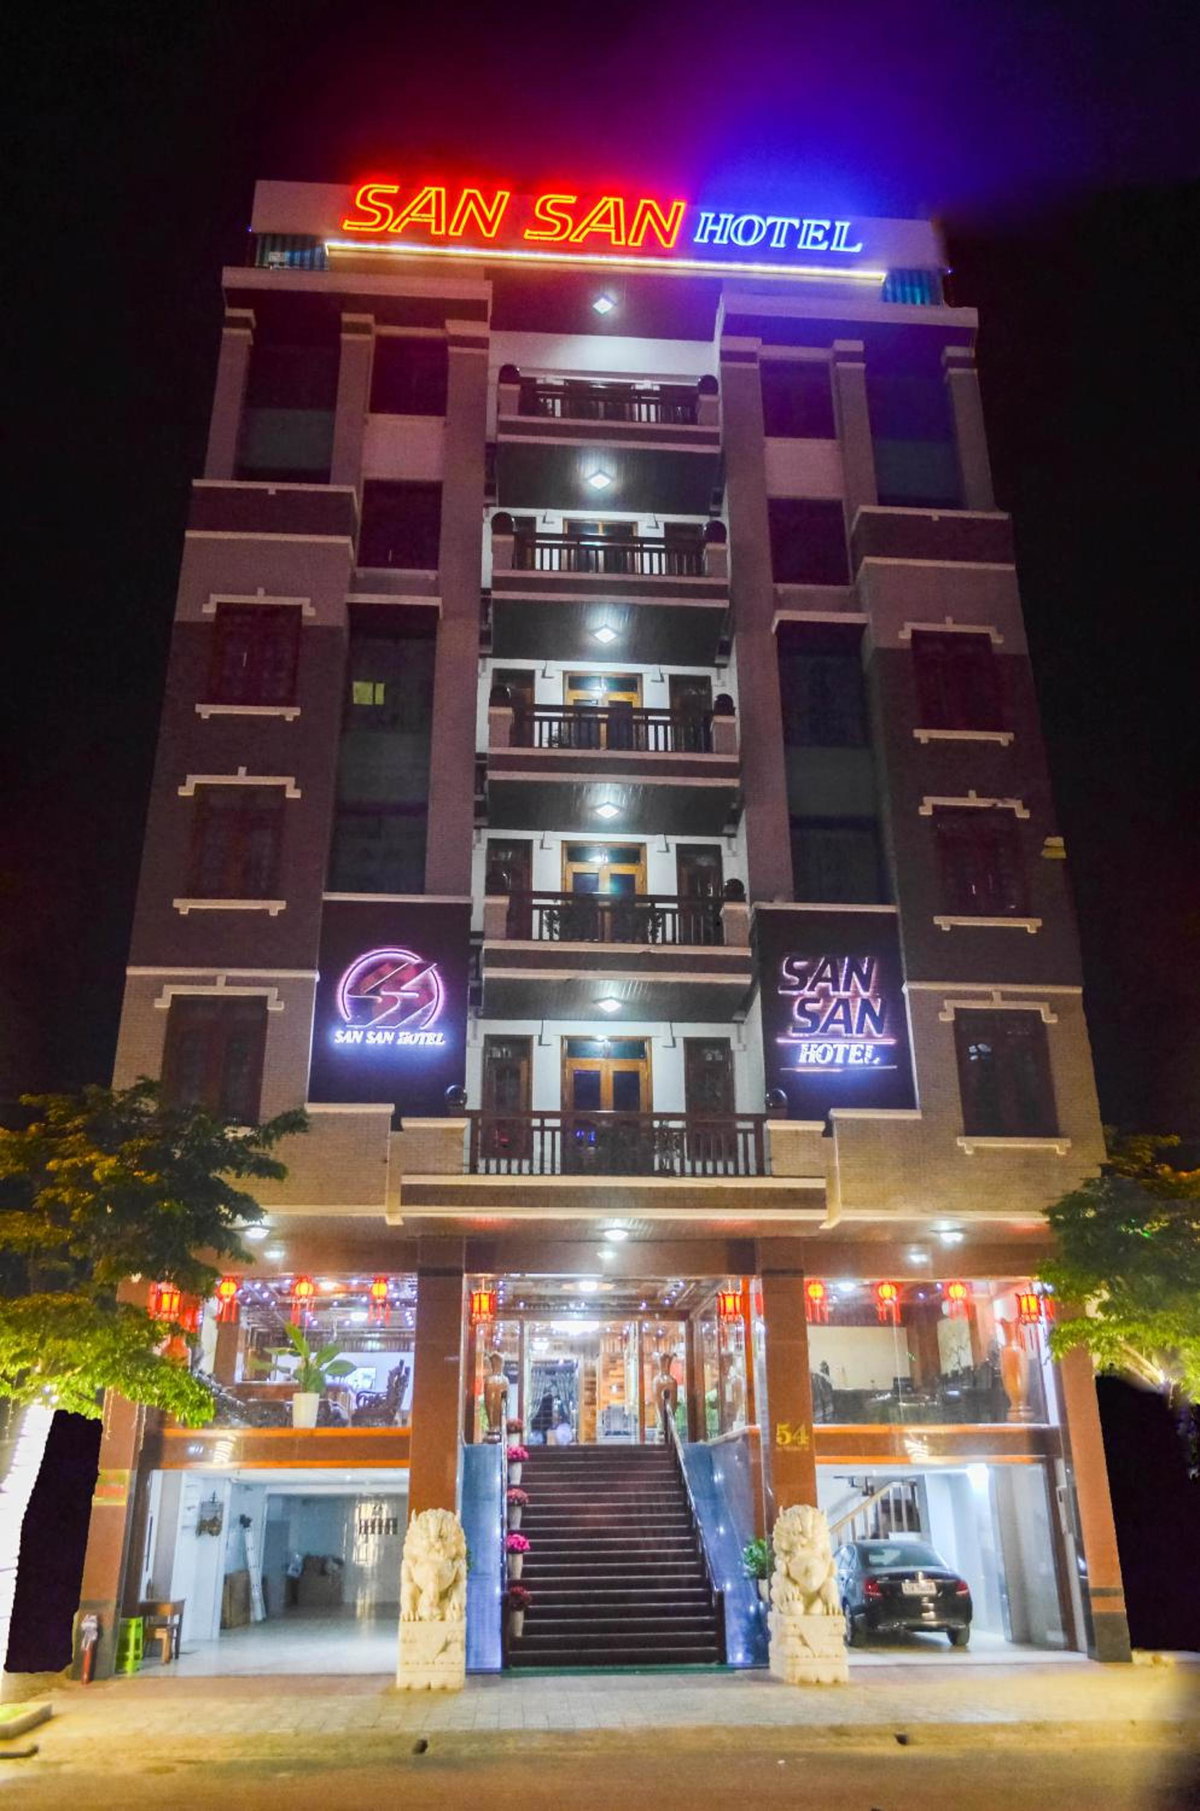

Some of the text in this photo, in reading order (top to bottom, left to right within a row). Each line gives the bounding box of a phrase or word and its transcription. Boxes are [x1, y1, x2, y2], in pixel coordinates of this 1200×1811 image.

[342, 184, 863, 253] SAN SAN HOTEL
[778, 956, 876, 996] SAN
[788, 997, 887, 1038] SAN
[334, 1030, 447, 1046] SAN SAN HOTEL
[798, 1043, 880, 1065] HOTEL
[776, 1423, 809, 1445] 54
